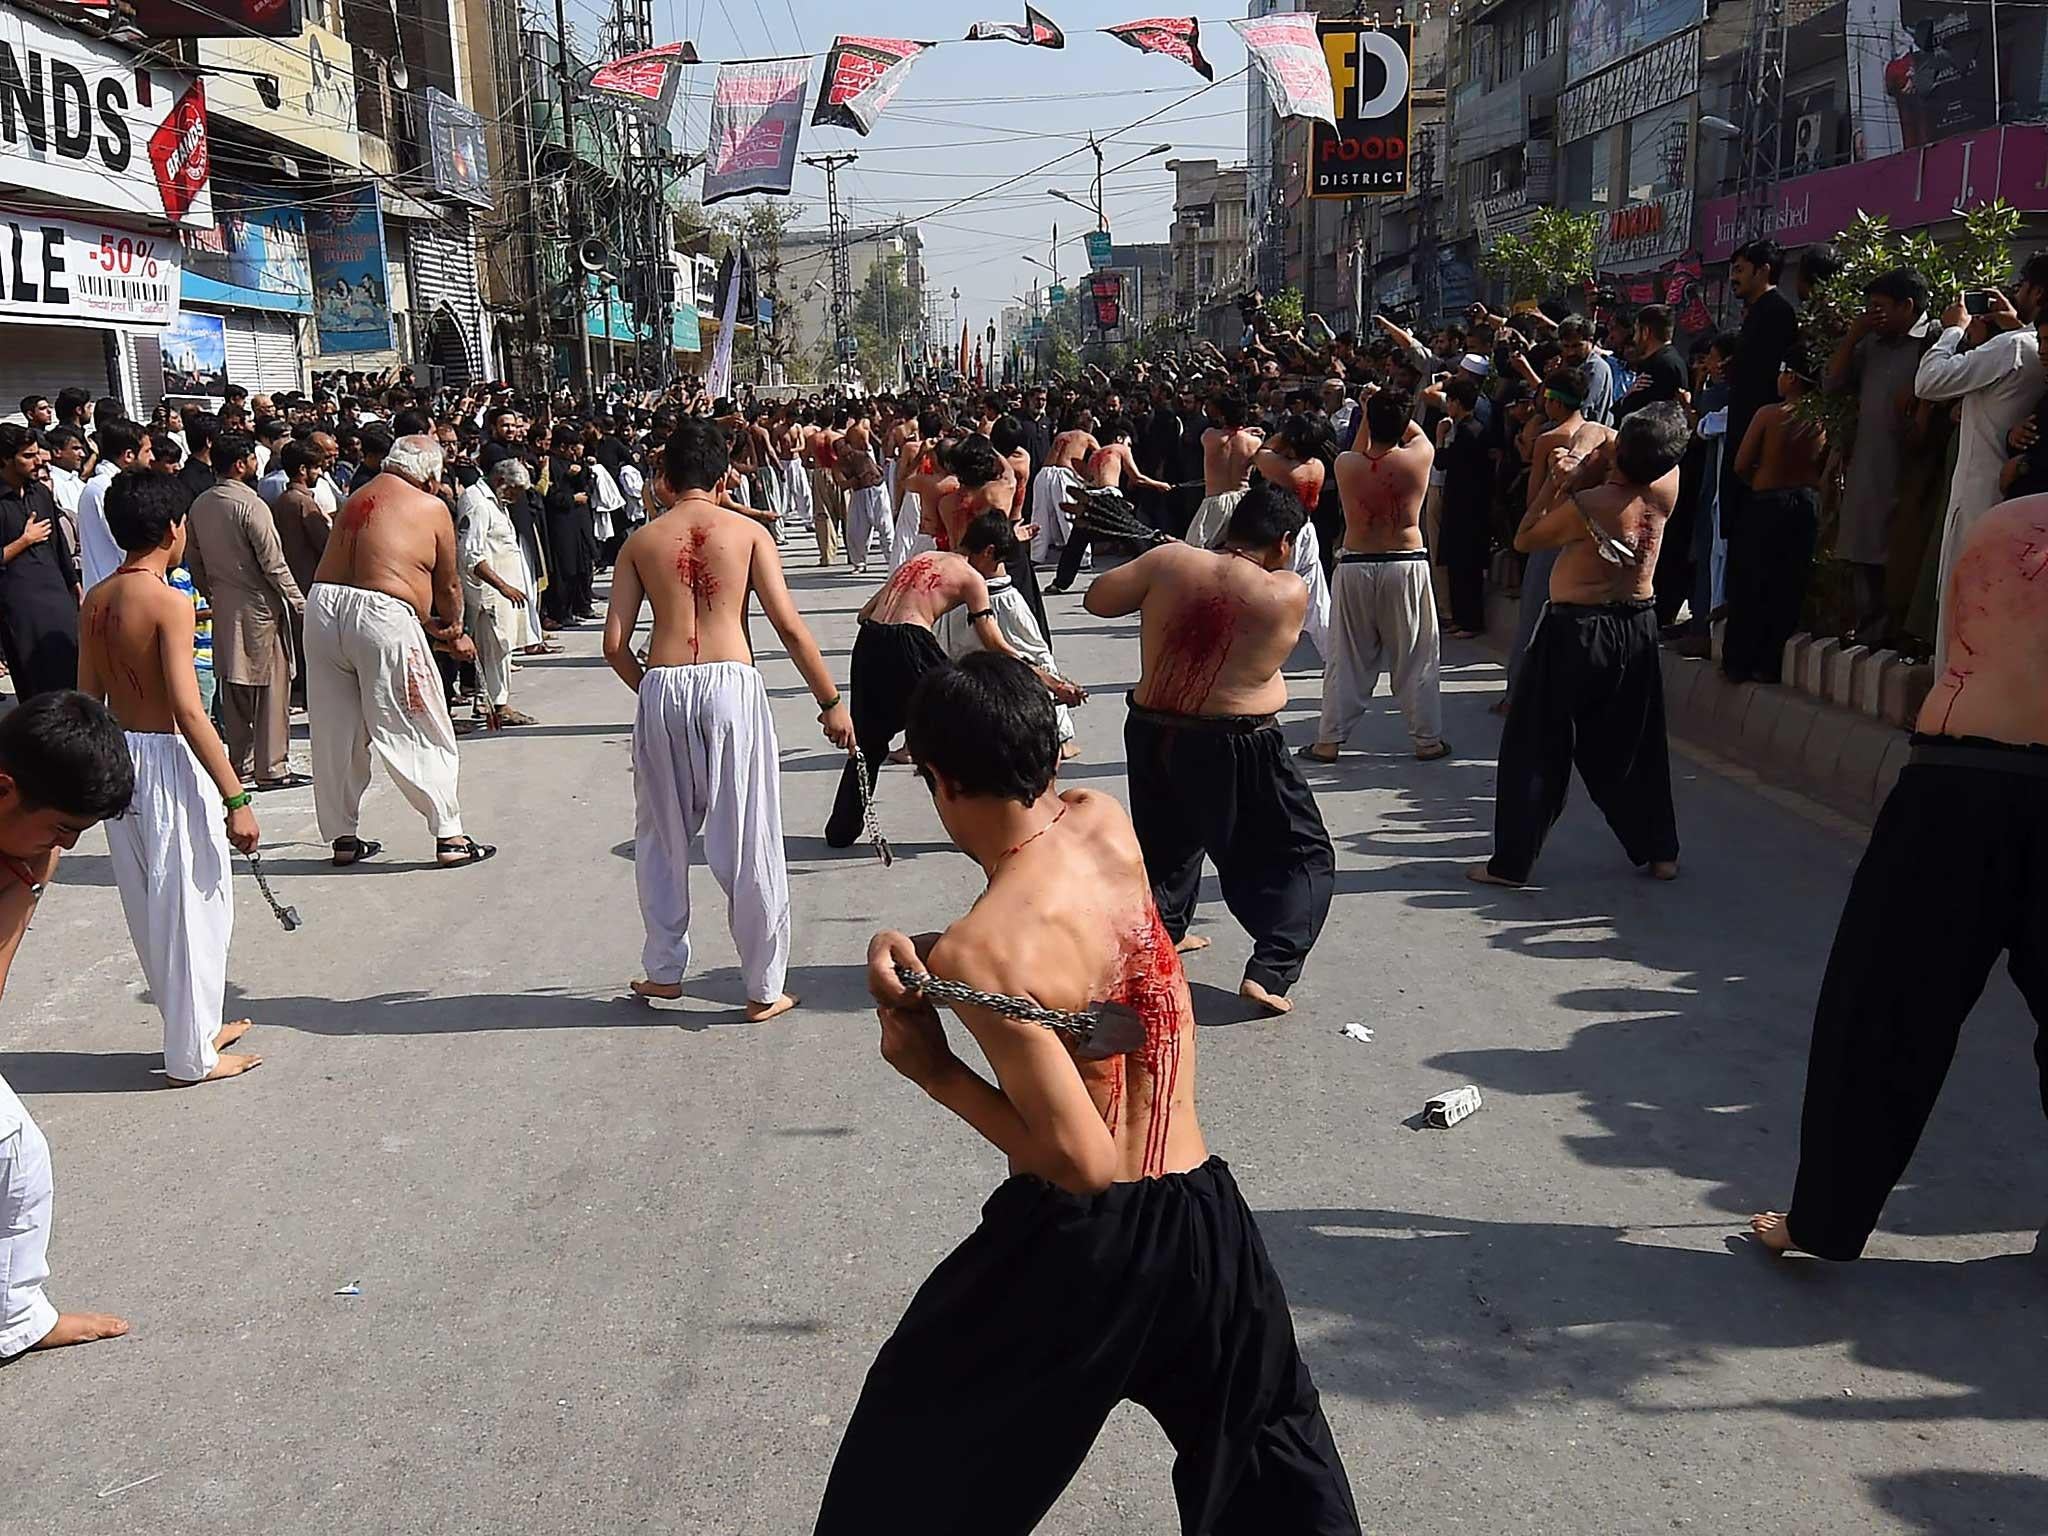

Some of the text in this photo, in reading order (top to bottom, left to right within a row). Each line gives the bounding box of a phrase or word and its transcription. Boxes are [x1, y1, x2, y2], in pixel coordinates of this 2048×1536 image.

[1323, 32, 1408, 119] FD
[166, 117, 204, 181] BRANDS
[1323, 137, 1404, 161] FOOD
[1320, 172, 1403, 186] DISTRICT
[0, 222, 70, 305] LE
[90, 234, 157, 278] -50%
